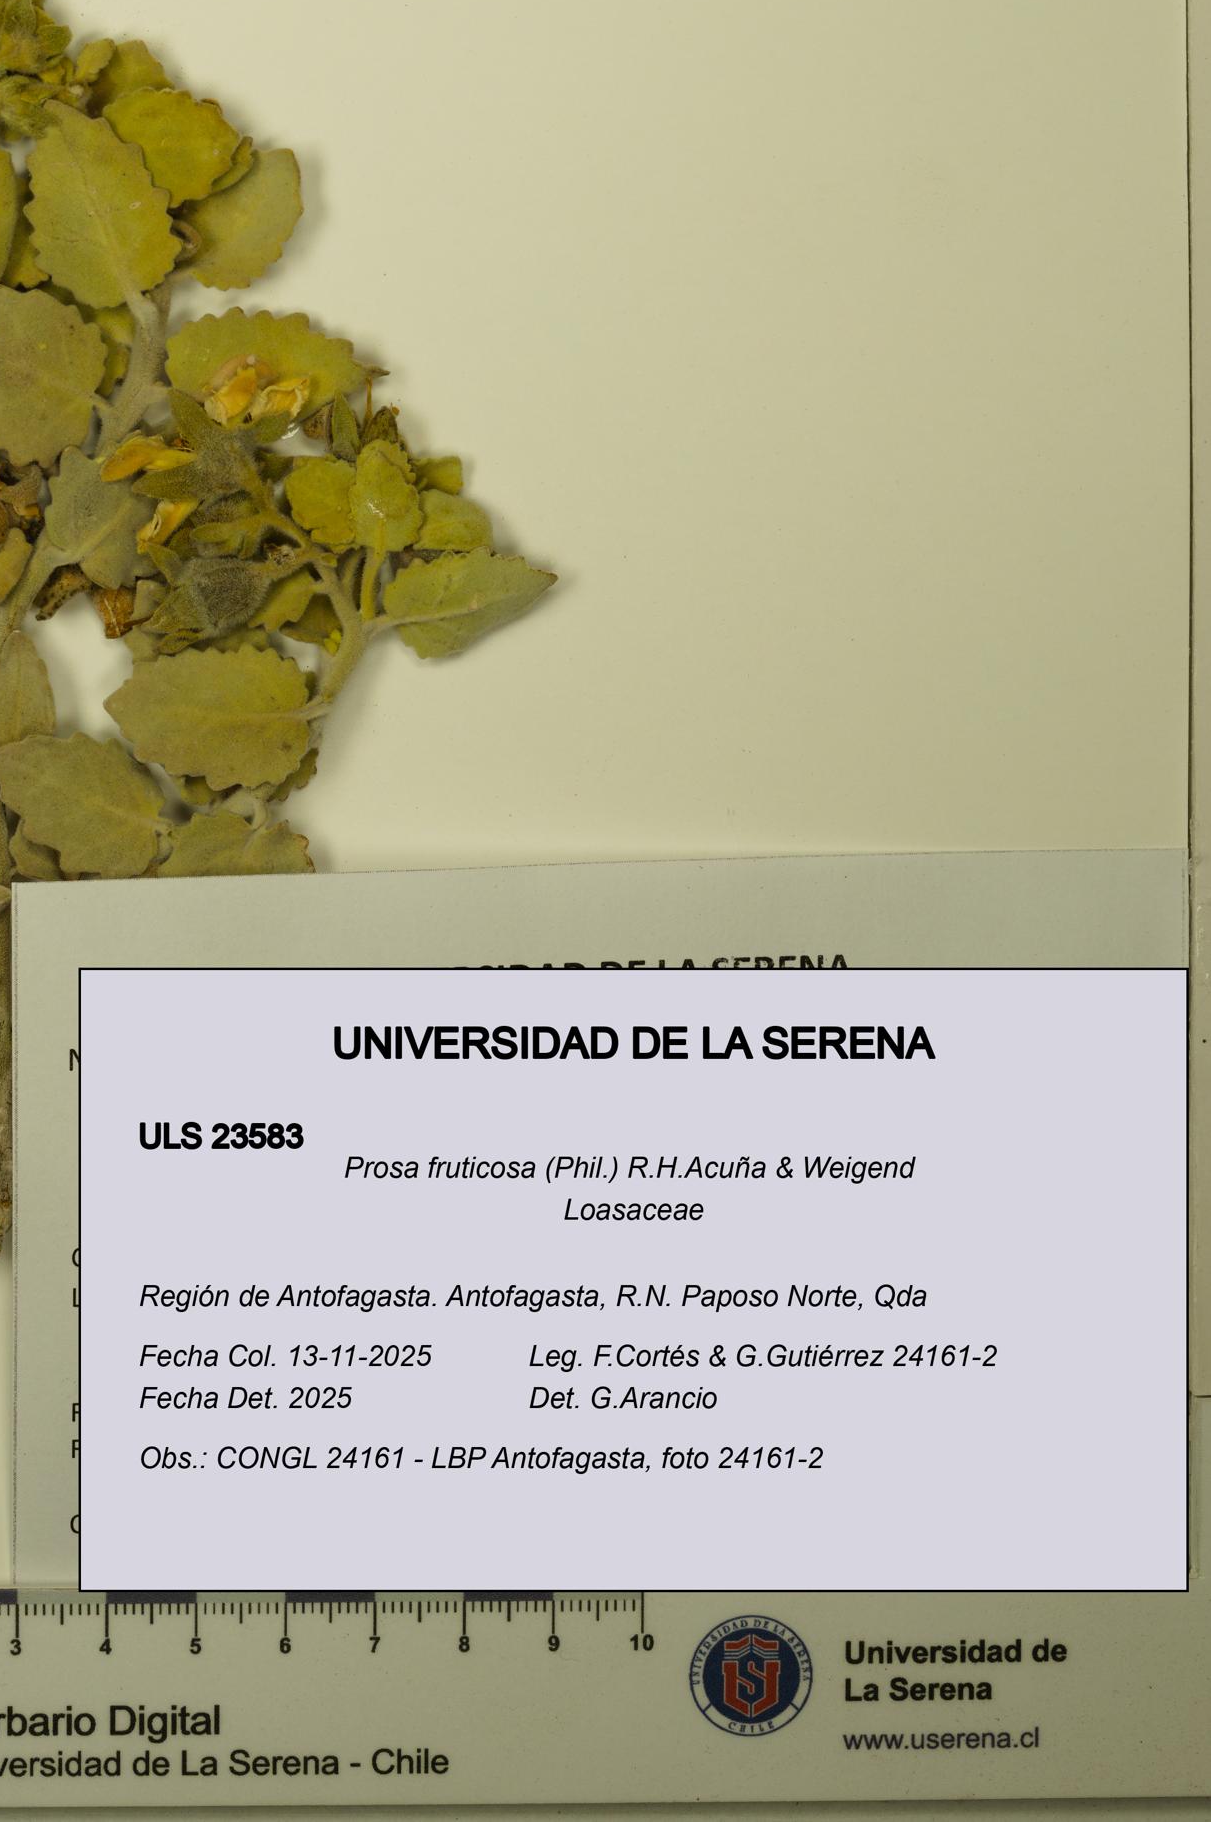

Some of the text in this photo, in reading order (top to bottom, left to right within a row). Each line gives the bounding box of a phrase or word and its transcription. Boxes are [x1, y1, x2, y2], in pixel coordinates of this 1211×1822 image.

[9, 1638, 22, 1656] 3
[98, 1638, 113, 1655] 4
[189, 1637, 202, 1655] 5
[279, 1636, 292, 1654] 6
[368, 1636, 381, 1653] 7
[458, 1635, 471, 1653] 8
[547, 1635, 561, 1652] 9
[629, 1634, 655, 1651] 10
[691, 1619, 749, 1686] UNIVERSIDAD
[752, 1619, 770, 1630] DE
[845, 1638, 1068, 1665] Universidad de
[845, 1677, 993, 1702] La Serena
[110, 1705, 221, 1744] Digital
[728, 1720, 774, 1733] CHILE
[843, 1726, 1040, 1750] www.userena.cl
[132, 1749, 171, 1777] de
[181, 1750, 218, 1777] La
[229, 1749, 340, 1776] Serena
[372, 1748, 450, 1775] Chile
